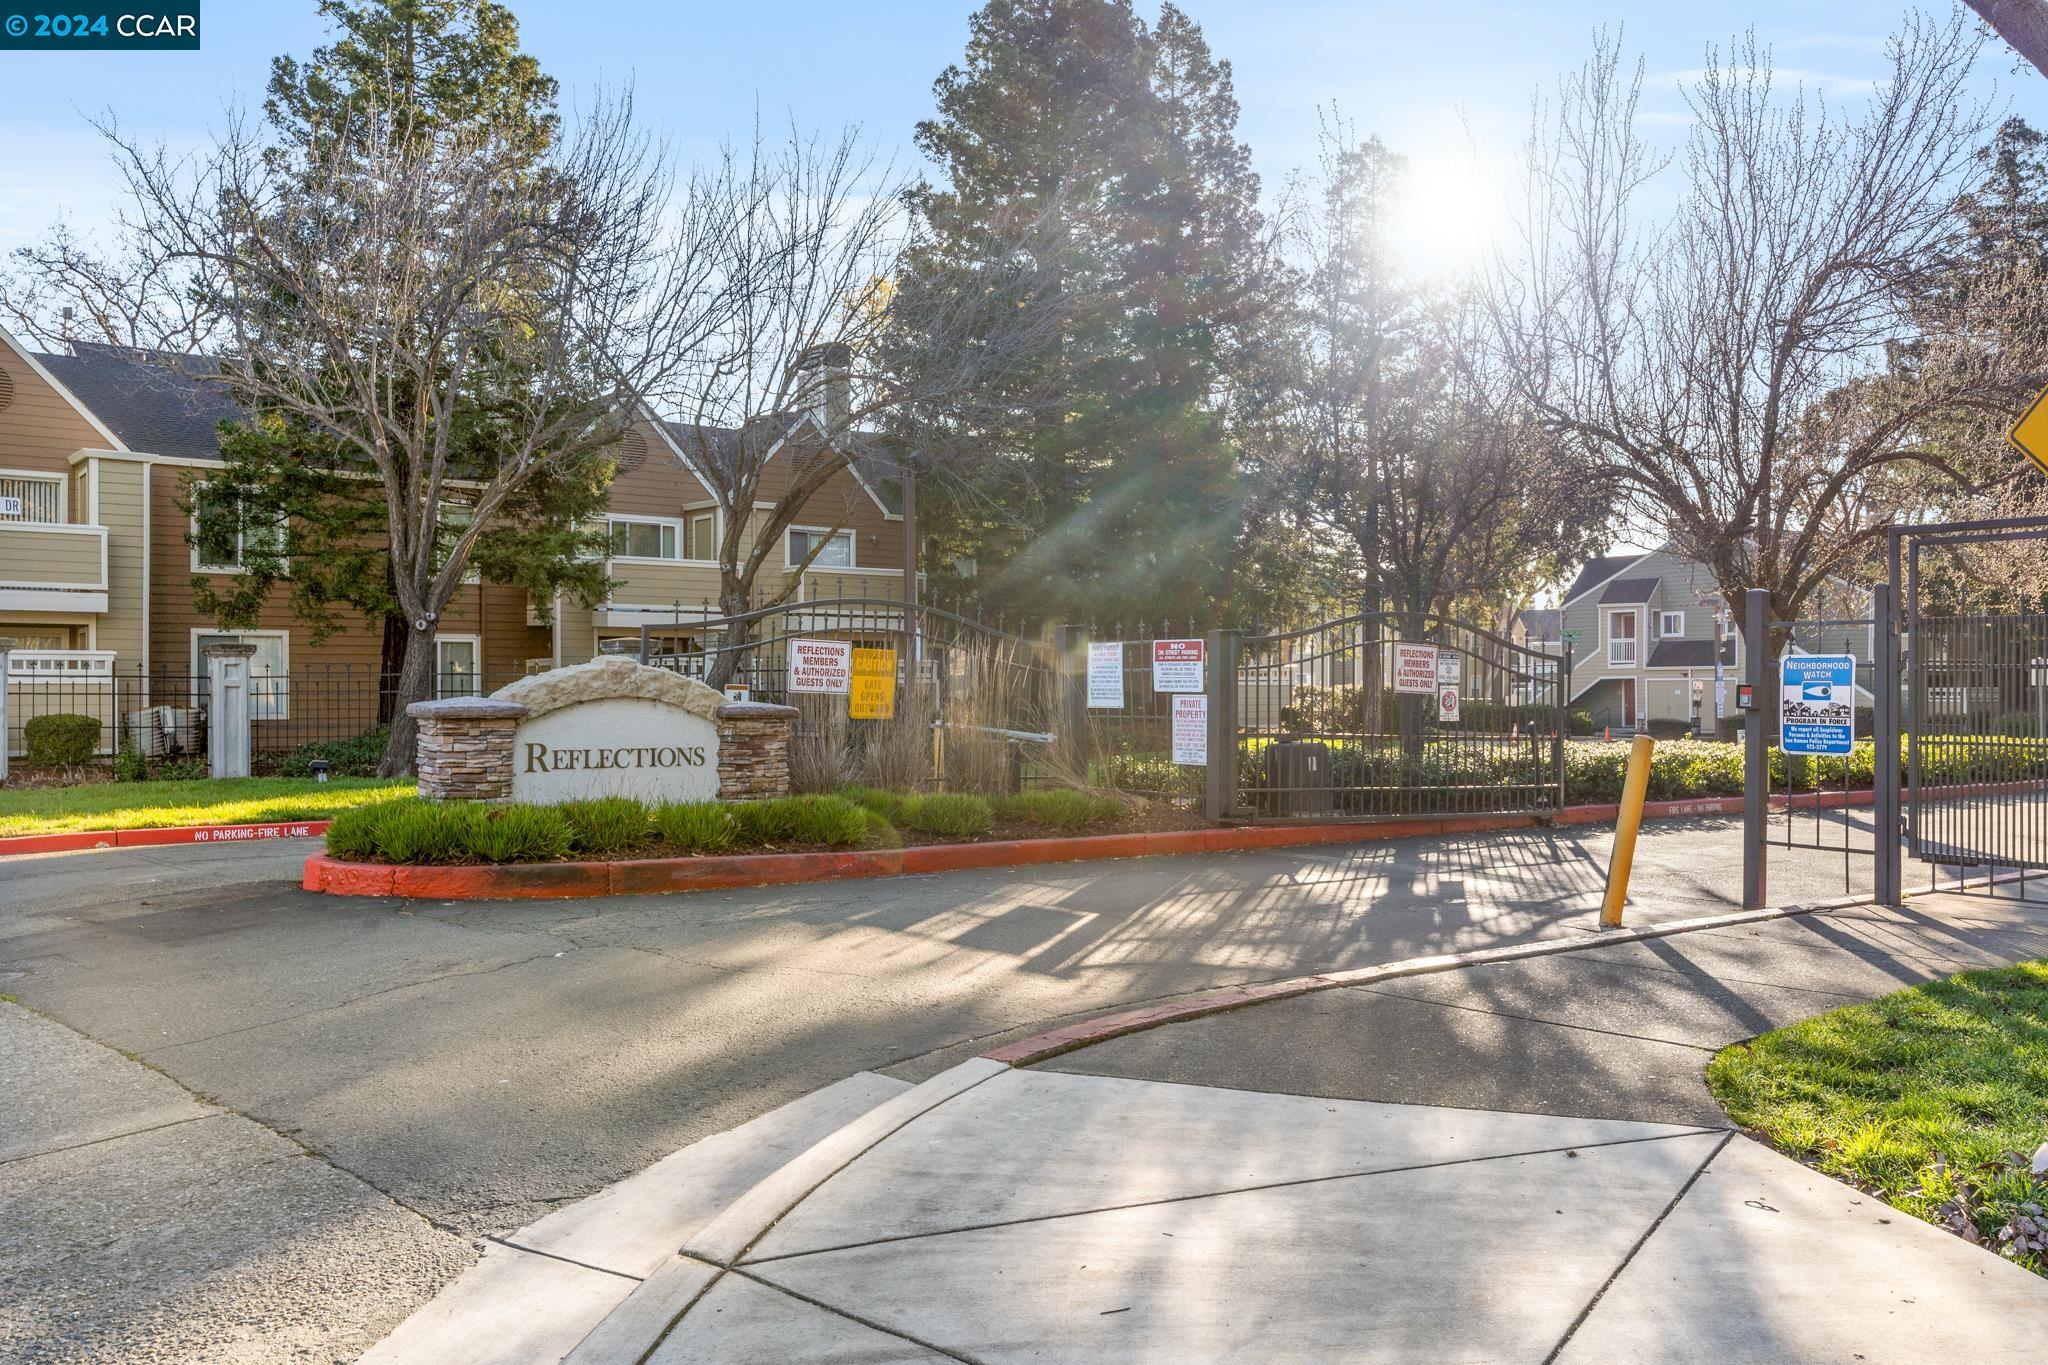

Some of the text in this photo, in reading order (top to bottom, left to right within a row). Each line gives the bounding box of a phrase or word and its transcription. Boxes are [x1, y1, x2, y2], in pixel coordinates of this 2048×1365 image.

[5, 499, 19, 512] DR
[797, 645, 845, 657] REFLECTIONS
[1400, 649, 1434, 659] REFLECTIONS
[802, 656, 839, 667] MEMBERS
[856, 657, 893, 672] CAUTION
[1403, 659, 1430, 669] MEMBERS
[793, 666, 846, 678] & AUTHORIZED
[1397, 668, 1401, 677] &
[1402, 669, 1435, 679] AUTHORIZED
[1803, 671, 1832, 680] WATCH
[796, 677, 843, 688] GUESTS ONLY
[864, 680, 882, 690] GATE
[1398, 678, 1434, 689] GUESTS ONLY
[860, 691, 884, 702] OPENS
[854, 703, 890, 714] OUTWARD
[1180, 700, 1202, 709] PRIVATE
[1175, 710, 1207, 719] PROPERTY
[1786, 717, 1817, 725] PROGRAM
[1828, 718, 1848, 726] FORCE
[194, 831, 209, 841] NO
[284, 826, 309, 837] LANE
